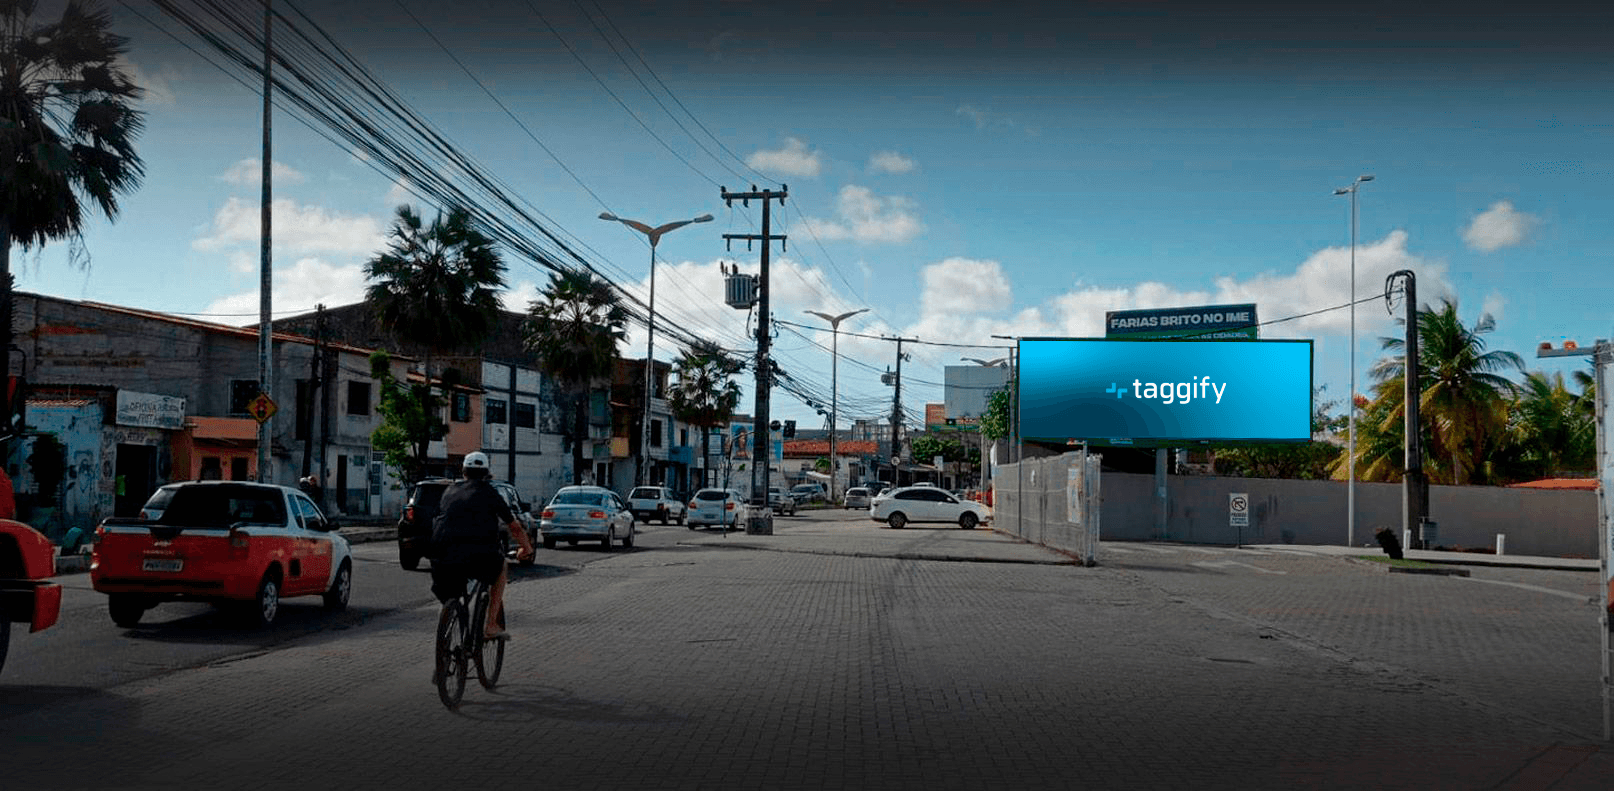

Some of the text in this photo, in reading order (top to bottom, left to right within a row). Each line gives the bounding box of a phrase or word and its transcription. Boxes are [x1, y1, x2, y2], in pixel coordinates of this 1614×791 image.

[1110, 311, 1250, 329] FARIAS BRITO NO IME
[1133, 376, 1227, 405] taggify
